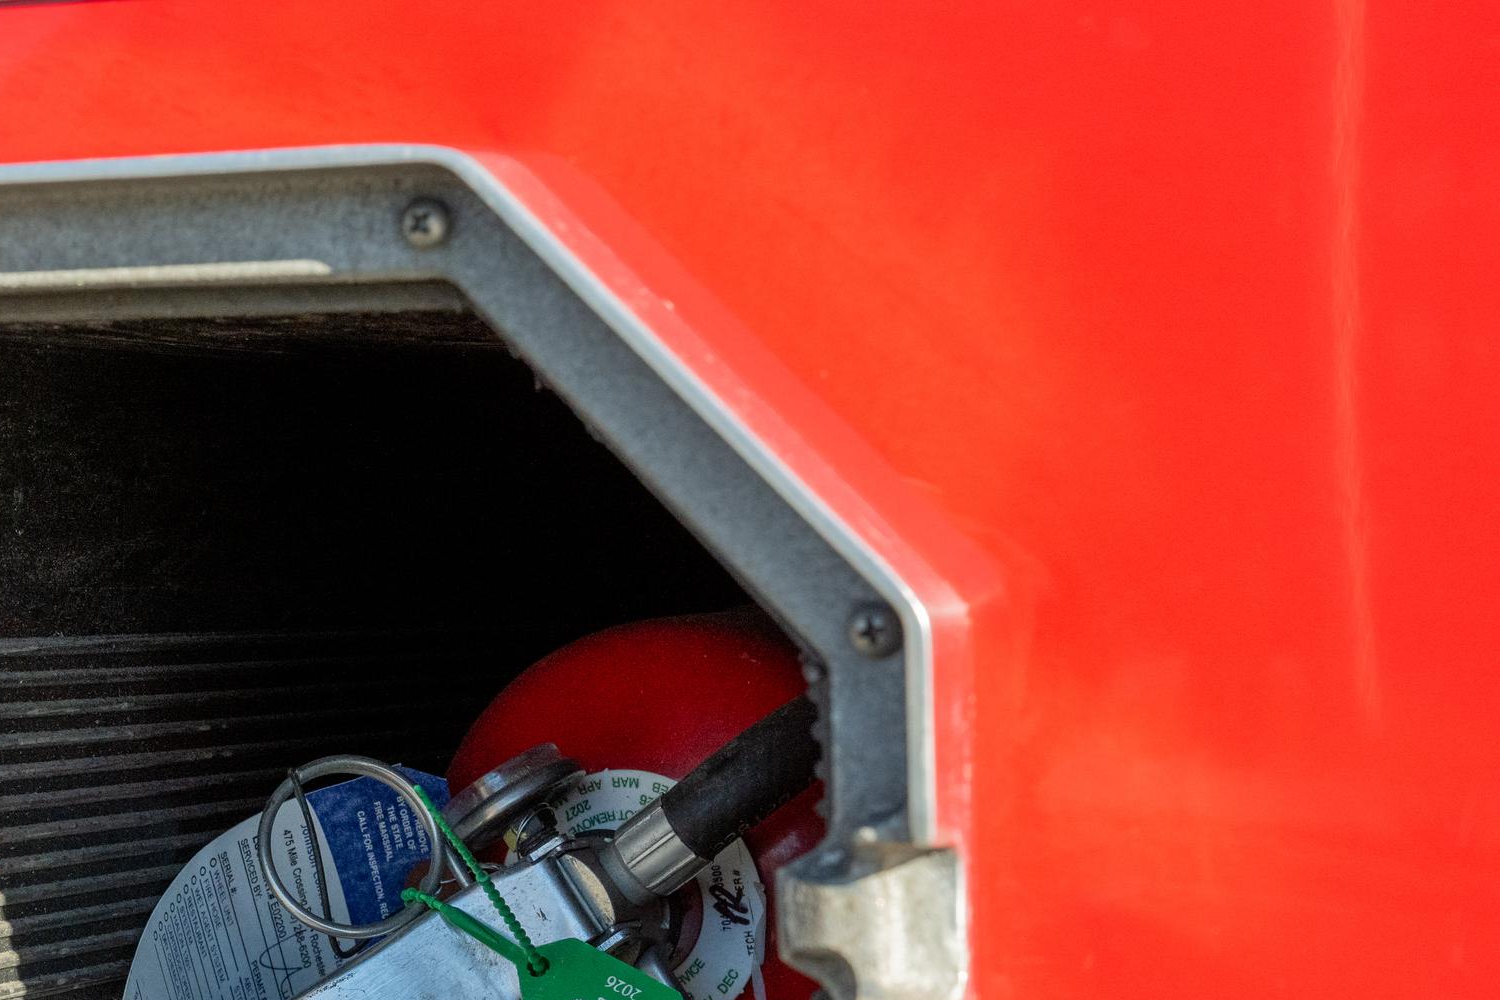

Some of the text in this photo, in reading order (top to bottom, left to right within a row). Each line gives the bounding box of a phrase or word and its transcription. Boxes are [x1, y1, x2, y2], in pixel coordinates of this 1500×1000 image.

[576, 776, 669, 795] EB MAR APR
[385, 805, 405, 851] THE STATE
[394, 794, 417, 852] BY ORDER OF
[563, 798, 591, 821] 2027
[567, 810, 614, 833] REMOVE
[281, 827, 295, 847] 475
[371, 800, 396, 862] FIRE MARSHAL
[219, 850, 235, 886] SERIAL
[239, 837, 259, 885] SERVICED
[286, 846, 300, 867] Mile
[355, 809, 391, 920] CALL FOR INSPECTION, REC
[202, 877, 215, 901] FIRE
[211, 868, 228, 905] WHEEL
[290, 866, 310, 907] Crossing
[269, 900, 288, 939] E02200
[308, 933, 328, 978] Rochester
[249, 958, 266, 995] PERMIT
[715, 967, 740, 995] DEC
